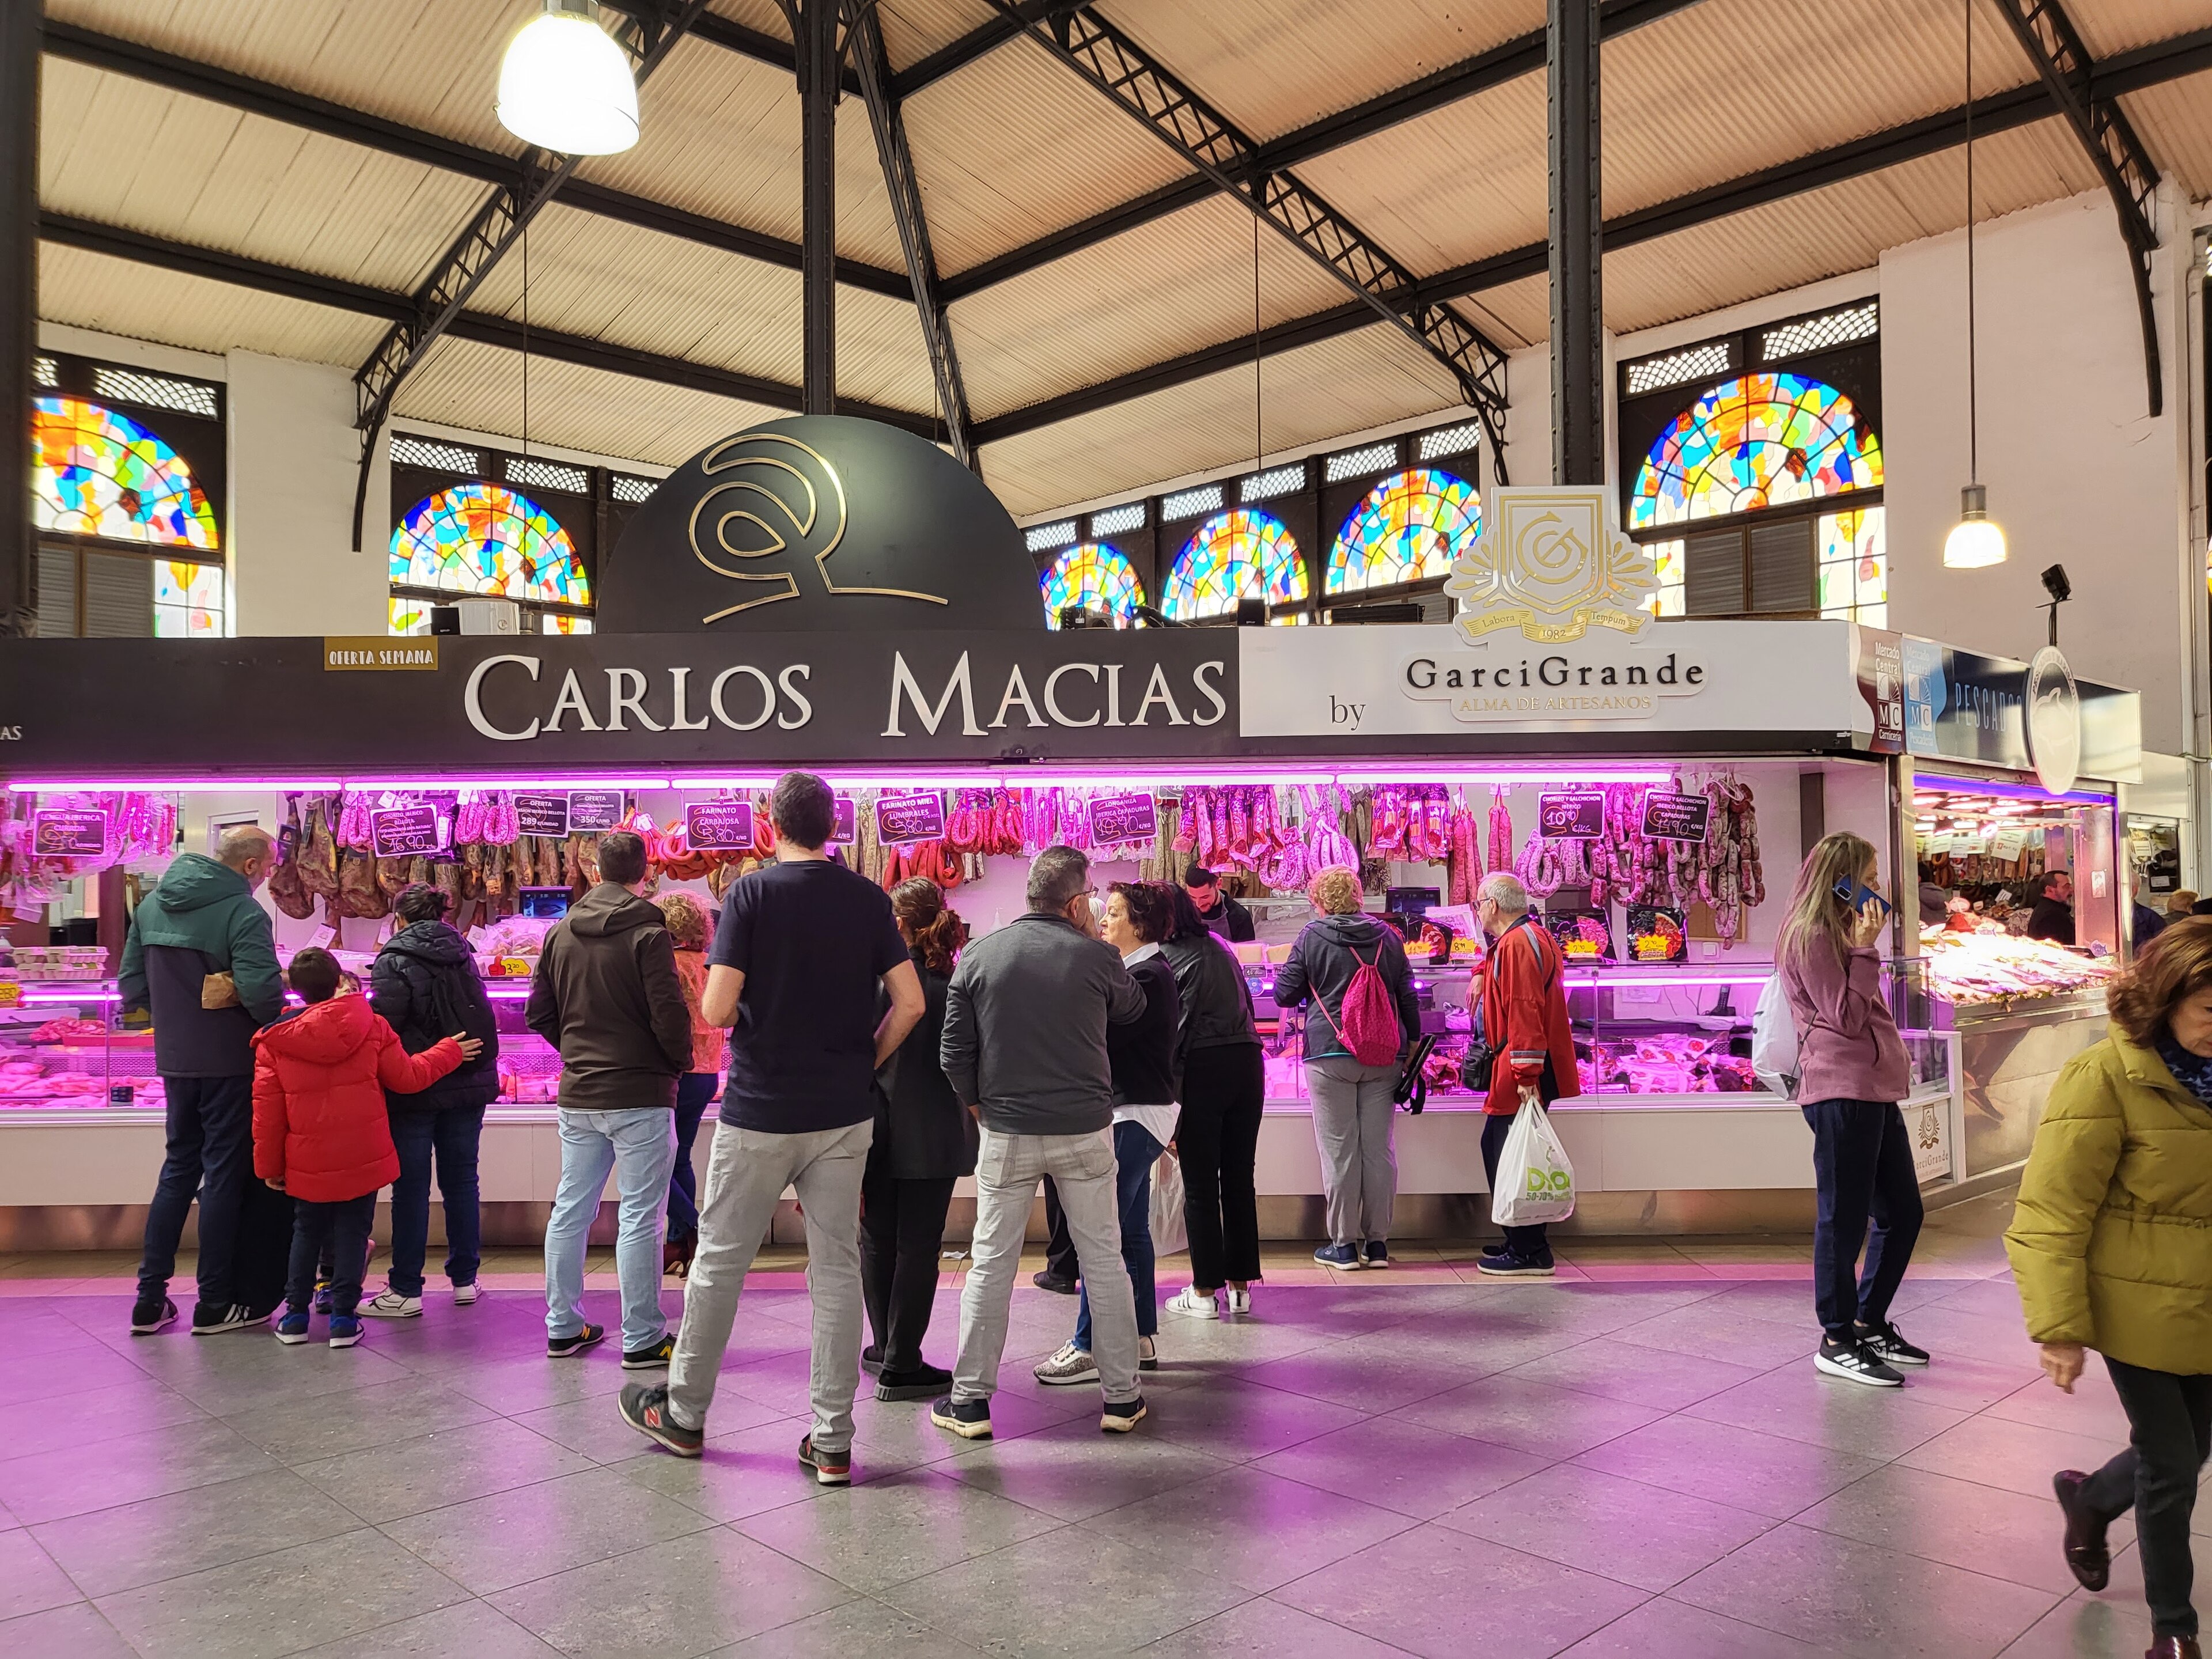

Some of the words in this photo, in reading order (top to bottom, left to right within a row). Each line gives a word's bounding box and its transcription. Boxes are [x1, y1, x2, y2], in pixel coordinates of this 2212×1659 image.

[1482, 614, 1515, 627] Labora
[1590, 611, 1626, 626] Tempum
[1542, 629, 1567, 639] 1982
[329, 650, 374, 665] OFERTA
[379, 649, 434, 664] SEMANA
[1875, 641, 1900, 660] Mercado
[1906, 646, 1930, 662] Mercado
[1407, 653, 1704, 689] GarciGrande
[1876, 658, 1900, 675] Central
[1907, 661, 1930, 676] Central
[464, 654, 813, 741] CARLOS
[881, 650, 1226, 737] MACIAS
[1460, 698, 1510, 711] ALMA
[1517, 697, 1540, 710] DE
[1545, 695, 1652, 710] ARTESANOS
[1329, 695, 1366, 731] by
[881, 800, 916, 810] FARINATO
[916, 797, 934, 806] MIEL
[1105, 798, 1137, 807] LONGANIZA
[1676, 797, 1707, 805] SALCHICHON
[889, 809, 930, 820] LUMBRALES
[1096, 810, 1117, 818] IBERICA
[1117, 805, 1150, 815] CAPADURAS
[1661, 812, 1691, 820] CAPADURAS
[521, 817, 537, 825] 289
[581, 816, 596, 824] 350
[699, 817, 740, 825] CARBAJOSA
[1526, 1191, 1554, 1201] 50-70%
